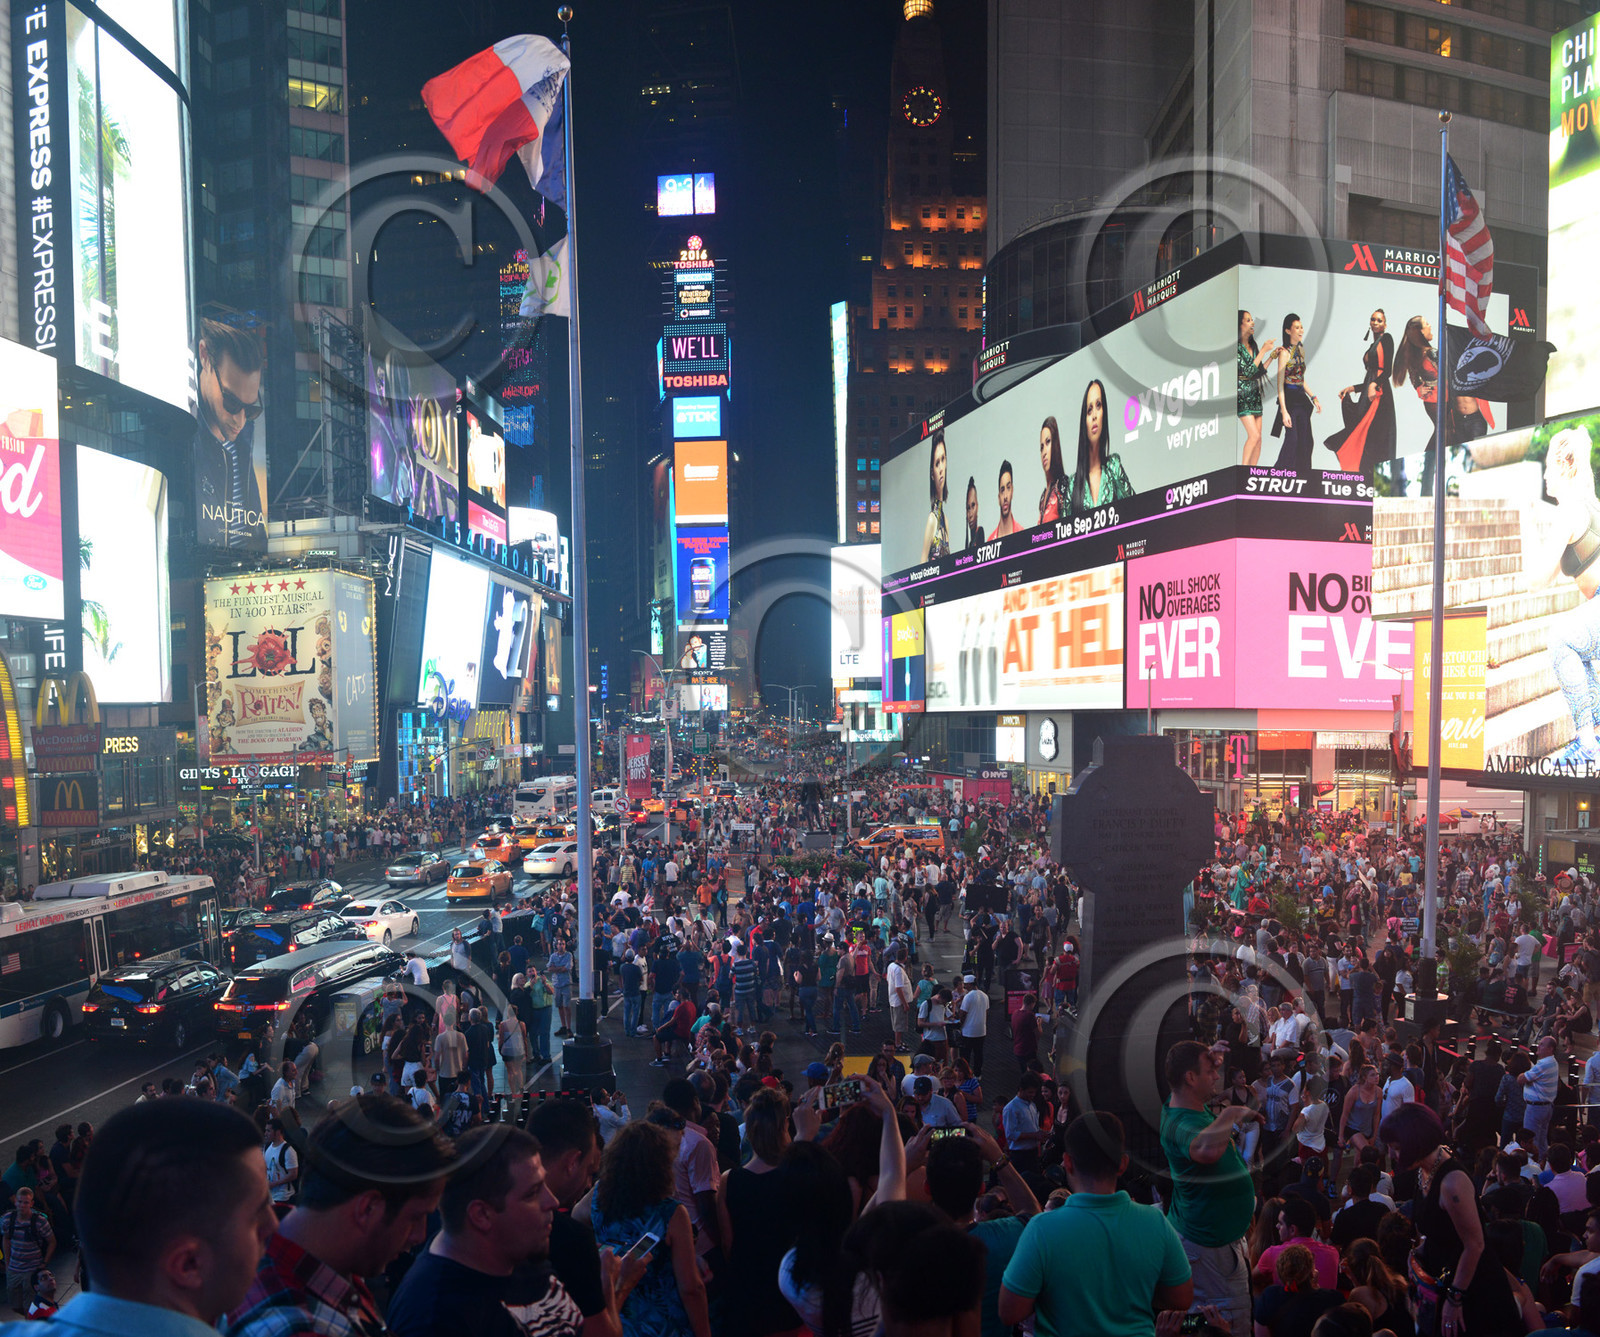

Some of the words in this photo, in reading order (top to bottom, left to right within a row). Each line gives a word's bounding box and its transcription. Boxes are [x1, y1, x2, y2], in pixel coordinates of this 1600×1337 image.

[26, 39, 52, 191] EXPRESS
[673, 260, 715, 270] TOSHIBA
[680, 249, 708, 261] 2016
[1385, 249, 1442, 265] MARRIOT
[1385, 261, 1442, 278] MARQUI
[1147, 269, 1181, 295] MARRIOTT
[1147, 284, 1177, 308] MARQUIS
[1513, 326, 1536, 334] MARRIOTT
[672, 336, 719, 359] WE'LL
[979, 341, 1010, 363] MARRIOTT
[979, 354, 1006, 374] MARQUIS
[664, 374, 728, 388] TOSHIBA
[1124, 361, 1219, 437] oxygen
[686, 411, 717, 422] TDK
[1166, 426, 1192, 451] very
[1194, 419, 1219, 439] real
[1250, 467, 1269, 476] New
[1271, 469, 1297, 478] Series
[1322, 471, 1364, 482] Premieres
[1165, 479, 1208, 508] oxygen
[1245, 476, 1308, 494] STRUT
[1321, 481, 1352, 497] Tue
[202, 503, 267, 528] NAUTICA
[1031, 529, 1053, 544] Premieres
[1055, 522, 1071, 540] Tue
[1074, 516, 1092, 538] Sep
[1093, 513, 1106, 532] 20
[1108, 507, 1120, 529] 9p
[976, 541, 1002, 564] STRUT
[1126, 539, 1147, 550] MARRIOTT
[1126, 548, 1145, 557] MARQUIS
[213, 598, 231, 609] THE
[234, 594, 281, 607] FUNNIEST
[283, 590, 324, 603] MUSICAL
[1139, 582, 1166, 621] NO
[1167, 579, 1186, 597] BILL
[1188, 573, 1221, 594] SHOCK
[1288, 572, 1349, 613] NO
[230, 608, 242, 619] IN
[245, 607, 266, 618] 400
[1167, 594, 1221, 617] OVERAGES
[44, 623, 65, 670] IFE
[226, 627, 316, 679] LOL
[1002, 614, 1041, 674] AT
[1139, 616, 1221, 680] EVER
[1288, 615, 1413, 681] EVE
[840, 654, 860, 665] LTE
[1443, 665, 1466, 677] HESE
[244, 685, 296, 694] SOMETHING
[345, 673, 366, 706] CATS
[240, 686, 303, 720] ROTTEN!
[432, 672, 471, 738] Disney
[474, 710, 505, 739] FOREVER
[1440, 708, 1485, 741] erie
[35, 733, 97, 746] McDonald's
[103, 736, 139, 754] PRESS
[627, 754, 650, 769] JERSEY
[1484, 754, 1578, 778] AMERICAN
[630, 767, 647, 780] BOYS
[990, 771, 1008, 779] NYC
[1092, 818, 1136, 829] FRANCIS
[1150, 817, 1185, 829] DUFFY
[115, 896, 134, 908] LETHAL
[134, 892, 154, 904] WEAPON
[15, 919, 39, 932] LETHAL
[39, 913, 65, 928] WEAPON
[552, 916, 559, 926] 9
